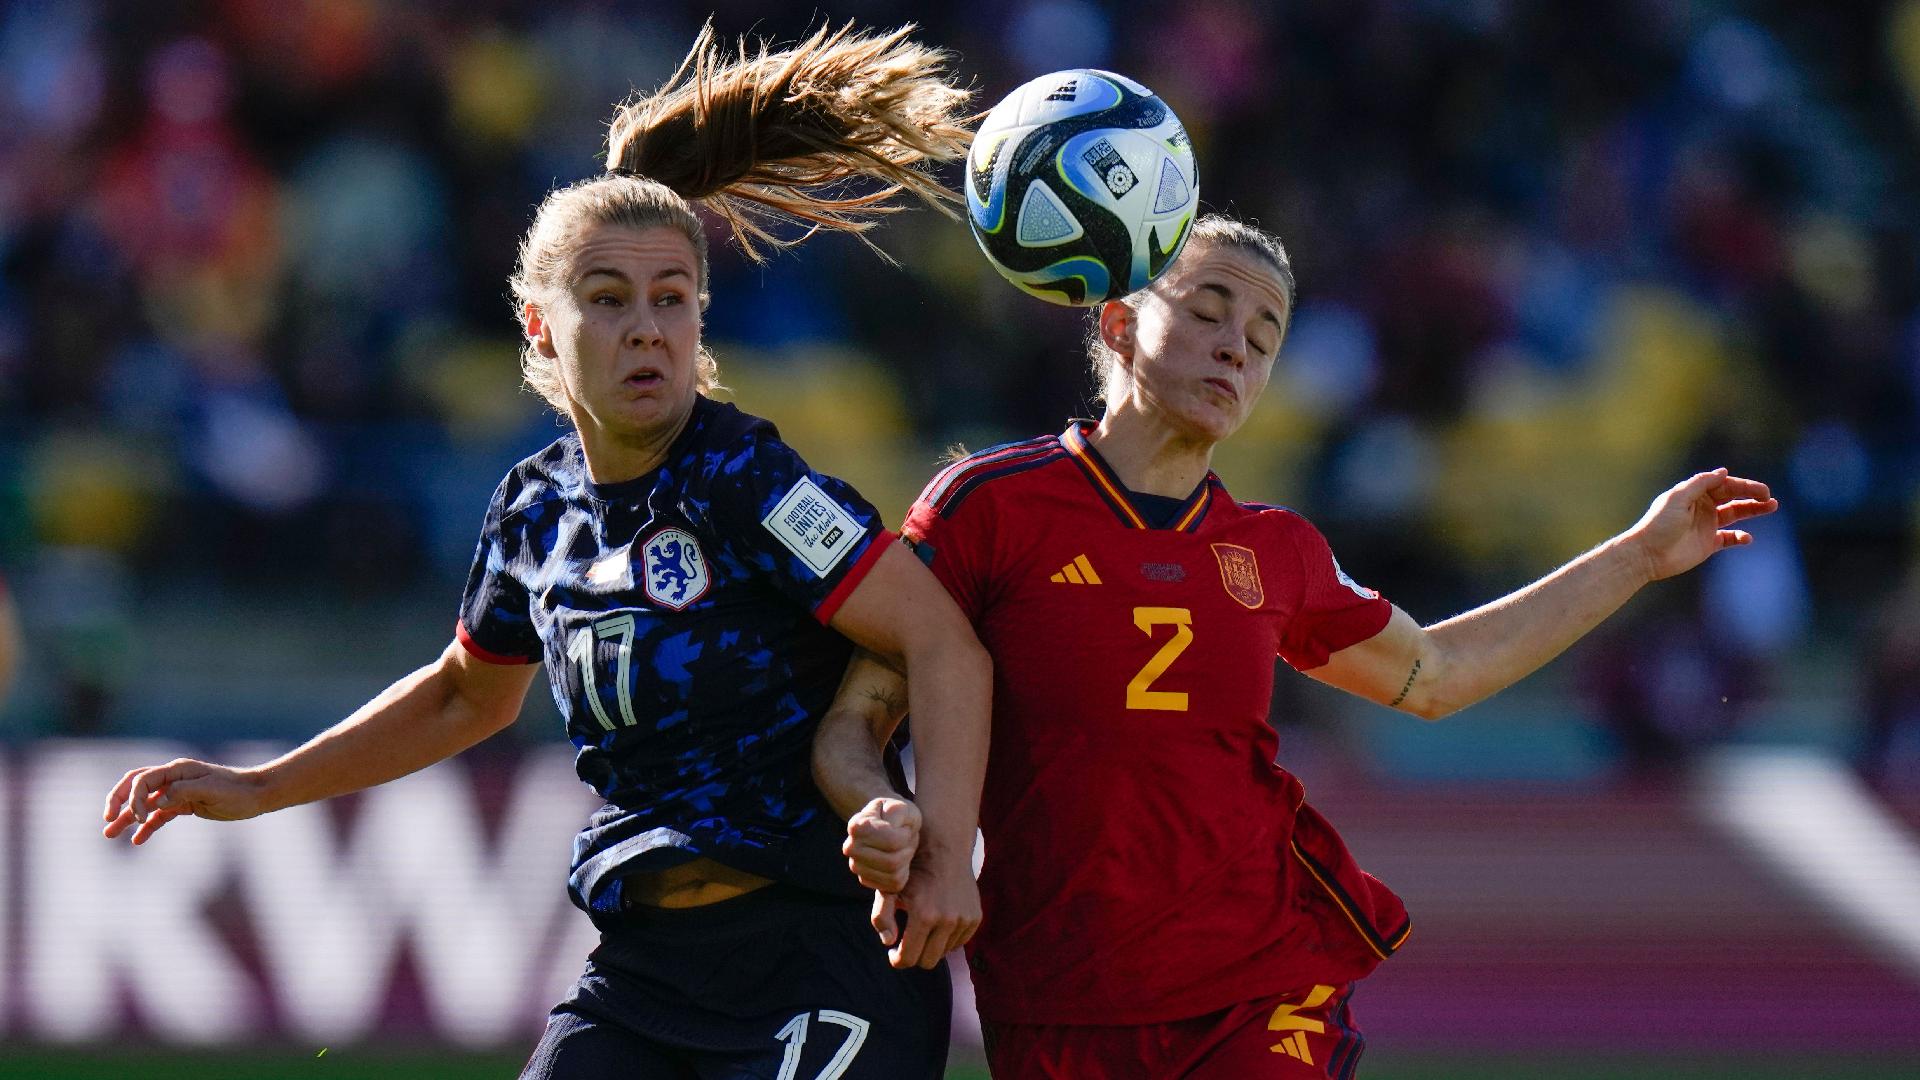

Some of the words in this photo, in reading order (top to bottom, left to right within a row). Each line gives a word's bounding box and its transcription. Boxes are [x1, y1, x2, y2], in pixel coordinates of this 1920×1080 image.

[784, 495, 815, 526] FOOTBALL
[793, 502, 826, 536] UNITES
[804, 535, 818, 548] the
[814, 510, 838, 535] World
[824, 530, 840, 546] FIFA
[567, 614, 637, 731] 17
[1126, 607, 1194, 711] 2
[774, 1010, 871, 1080] 17
